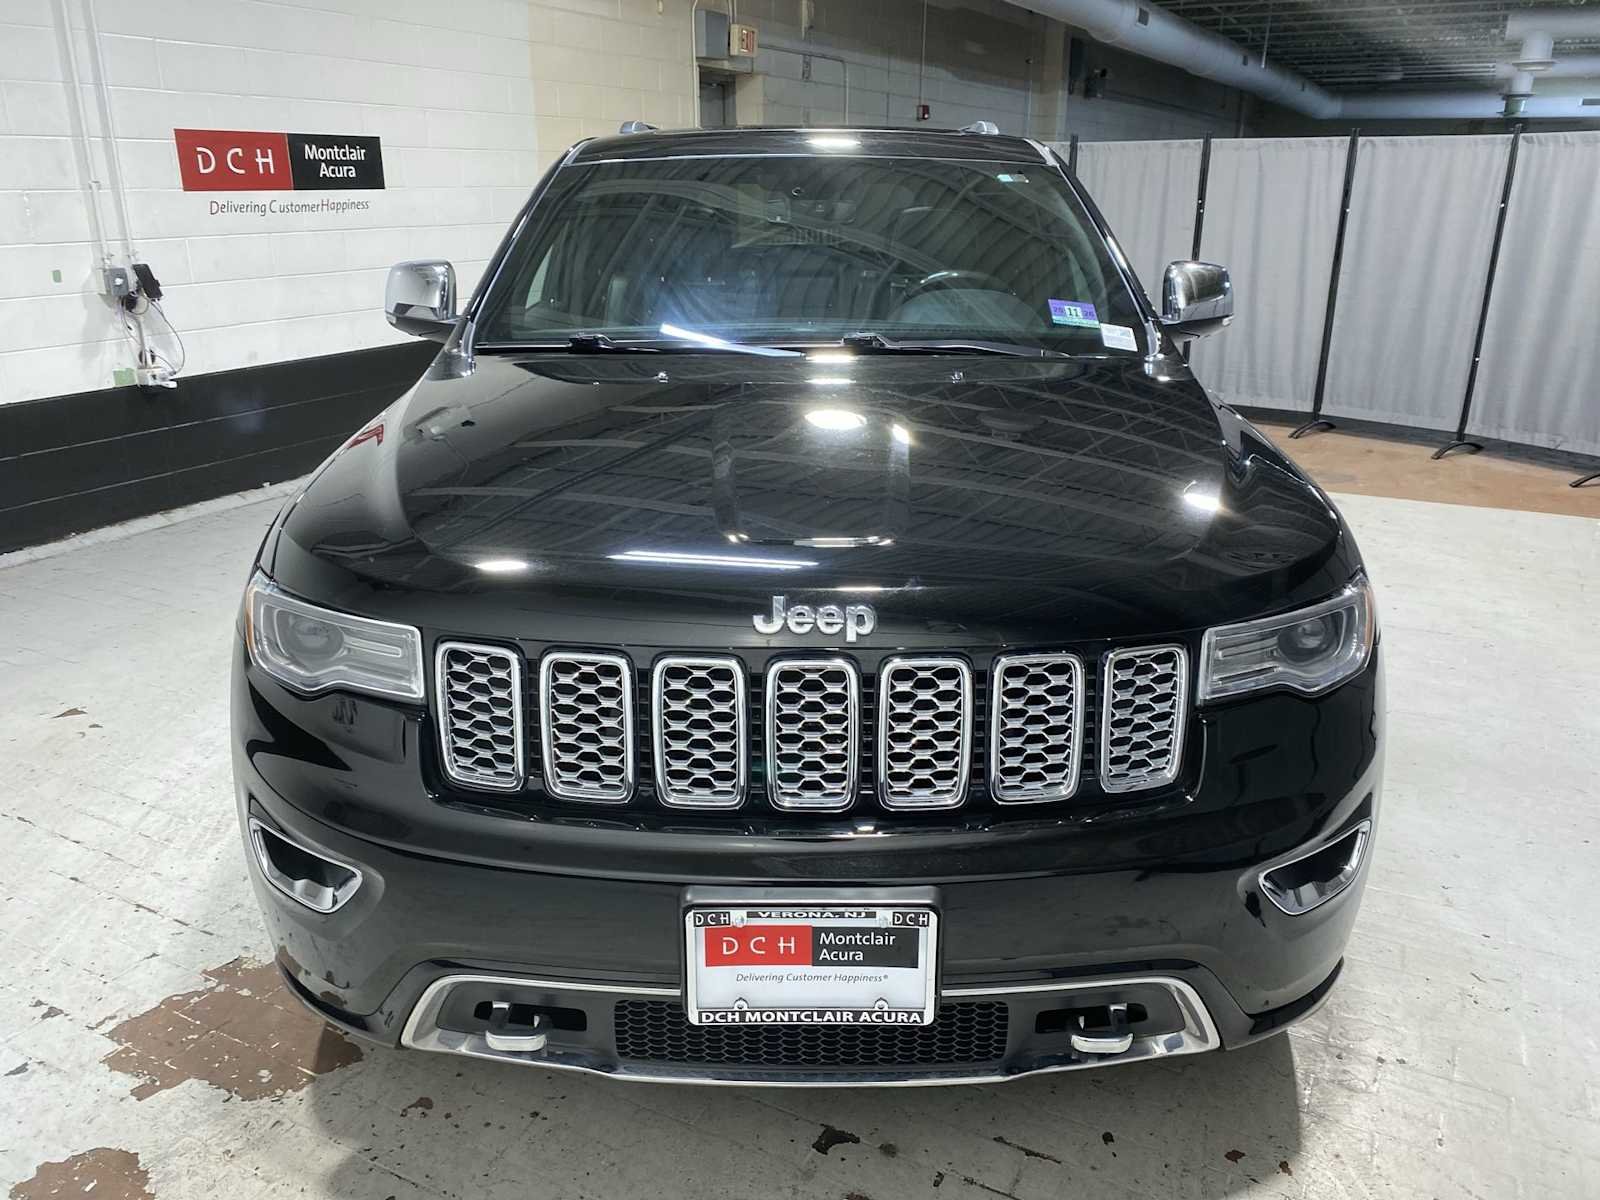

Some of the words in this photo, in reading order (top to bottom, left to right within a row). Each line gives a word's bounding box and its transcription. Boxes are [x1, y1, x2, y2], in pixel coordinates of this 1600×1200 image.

[304, 144, 366, 161] Montclair
[319, 162, 356, 178] Acura
[209, 200, 267, 217] Delivering
[1067, 306, 1079, 317] 11
[752, 595, 875, 642] Jeep
[695, 914, 730, 926] DCH
[894, 913, 928, 926] DCH
[722, 936, 795, 955] DCH
[819, 933, 896, 946] Montclair
[819, 948, 864, 962] Acura
[736, 973, 784, 984] Delivering
[786, 973, 832, 983] Customer
[701, 1011, 739, 1023] DCH
[745, 1011, 854, 1023] MONTCLAIR
[858, 1011, 922, 1024] ACURA
